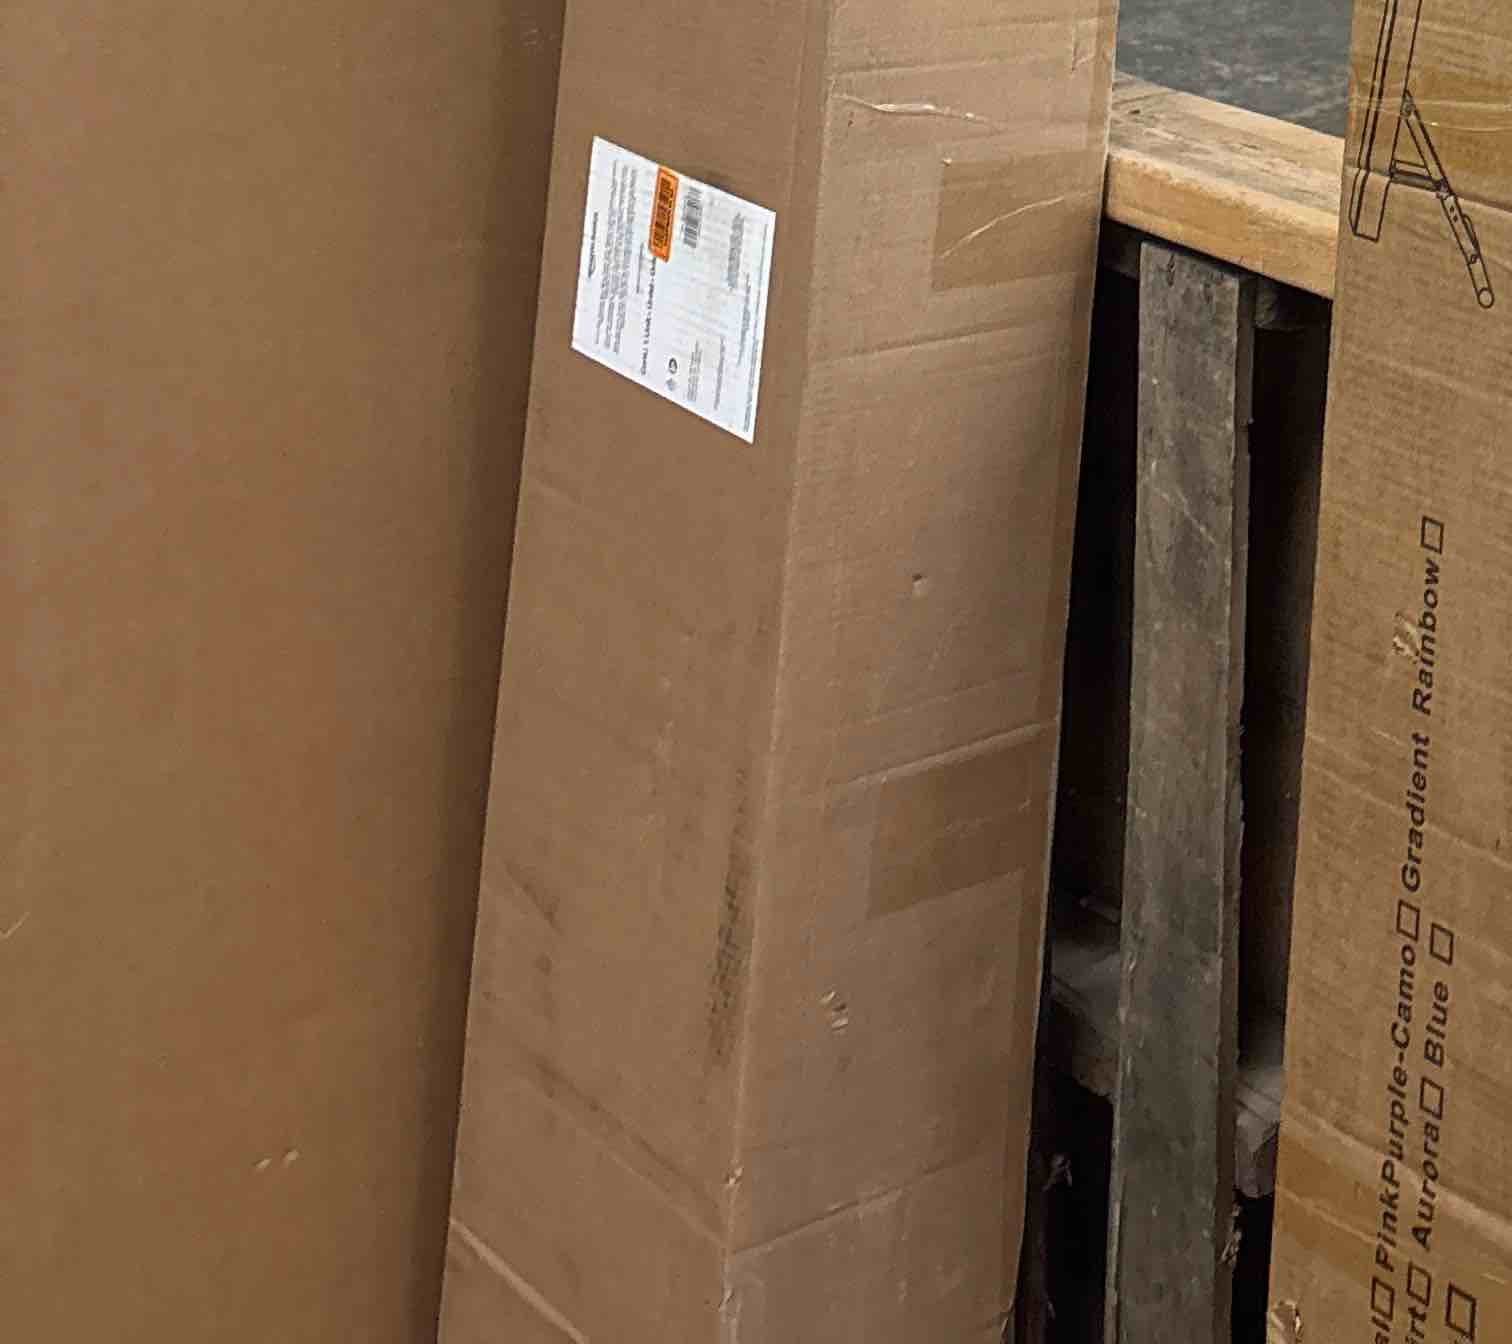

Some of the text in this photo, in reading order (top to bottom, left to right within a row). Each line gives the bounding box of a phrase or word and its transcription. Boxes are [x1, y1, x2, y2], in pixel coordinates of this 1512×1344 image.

[1375, 559, 1441, 1273] PinkPurple-Camo Gradient Rainbow
[1411, 980, 1450, 1252] Aurora Blue
